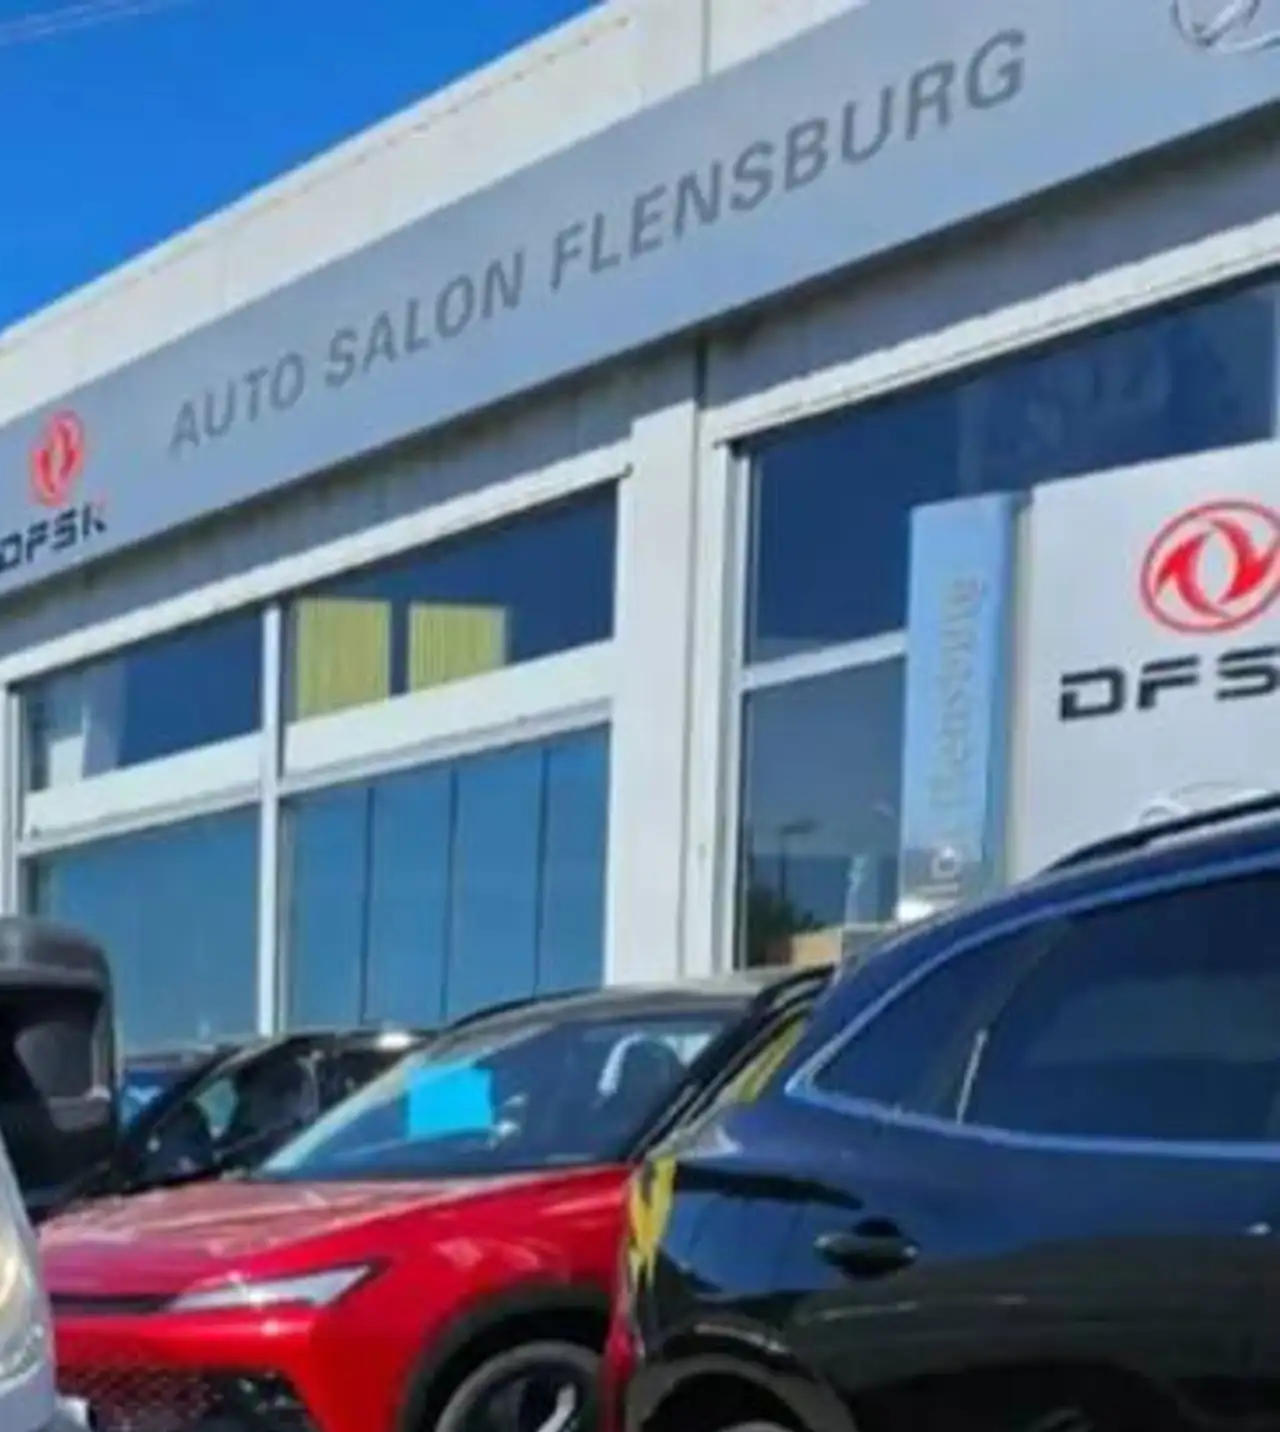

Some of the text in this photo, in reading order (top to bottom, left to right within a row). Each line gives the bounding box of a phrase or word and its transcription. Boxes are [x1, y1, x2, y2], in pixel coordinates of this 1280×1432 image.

[169, 29, 1027, 457] AUTO SALON FLENSBURG
